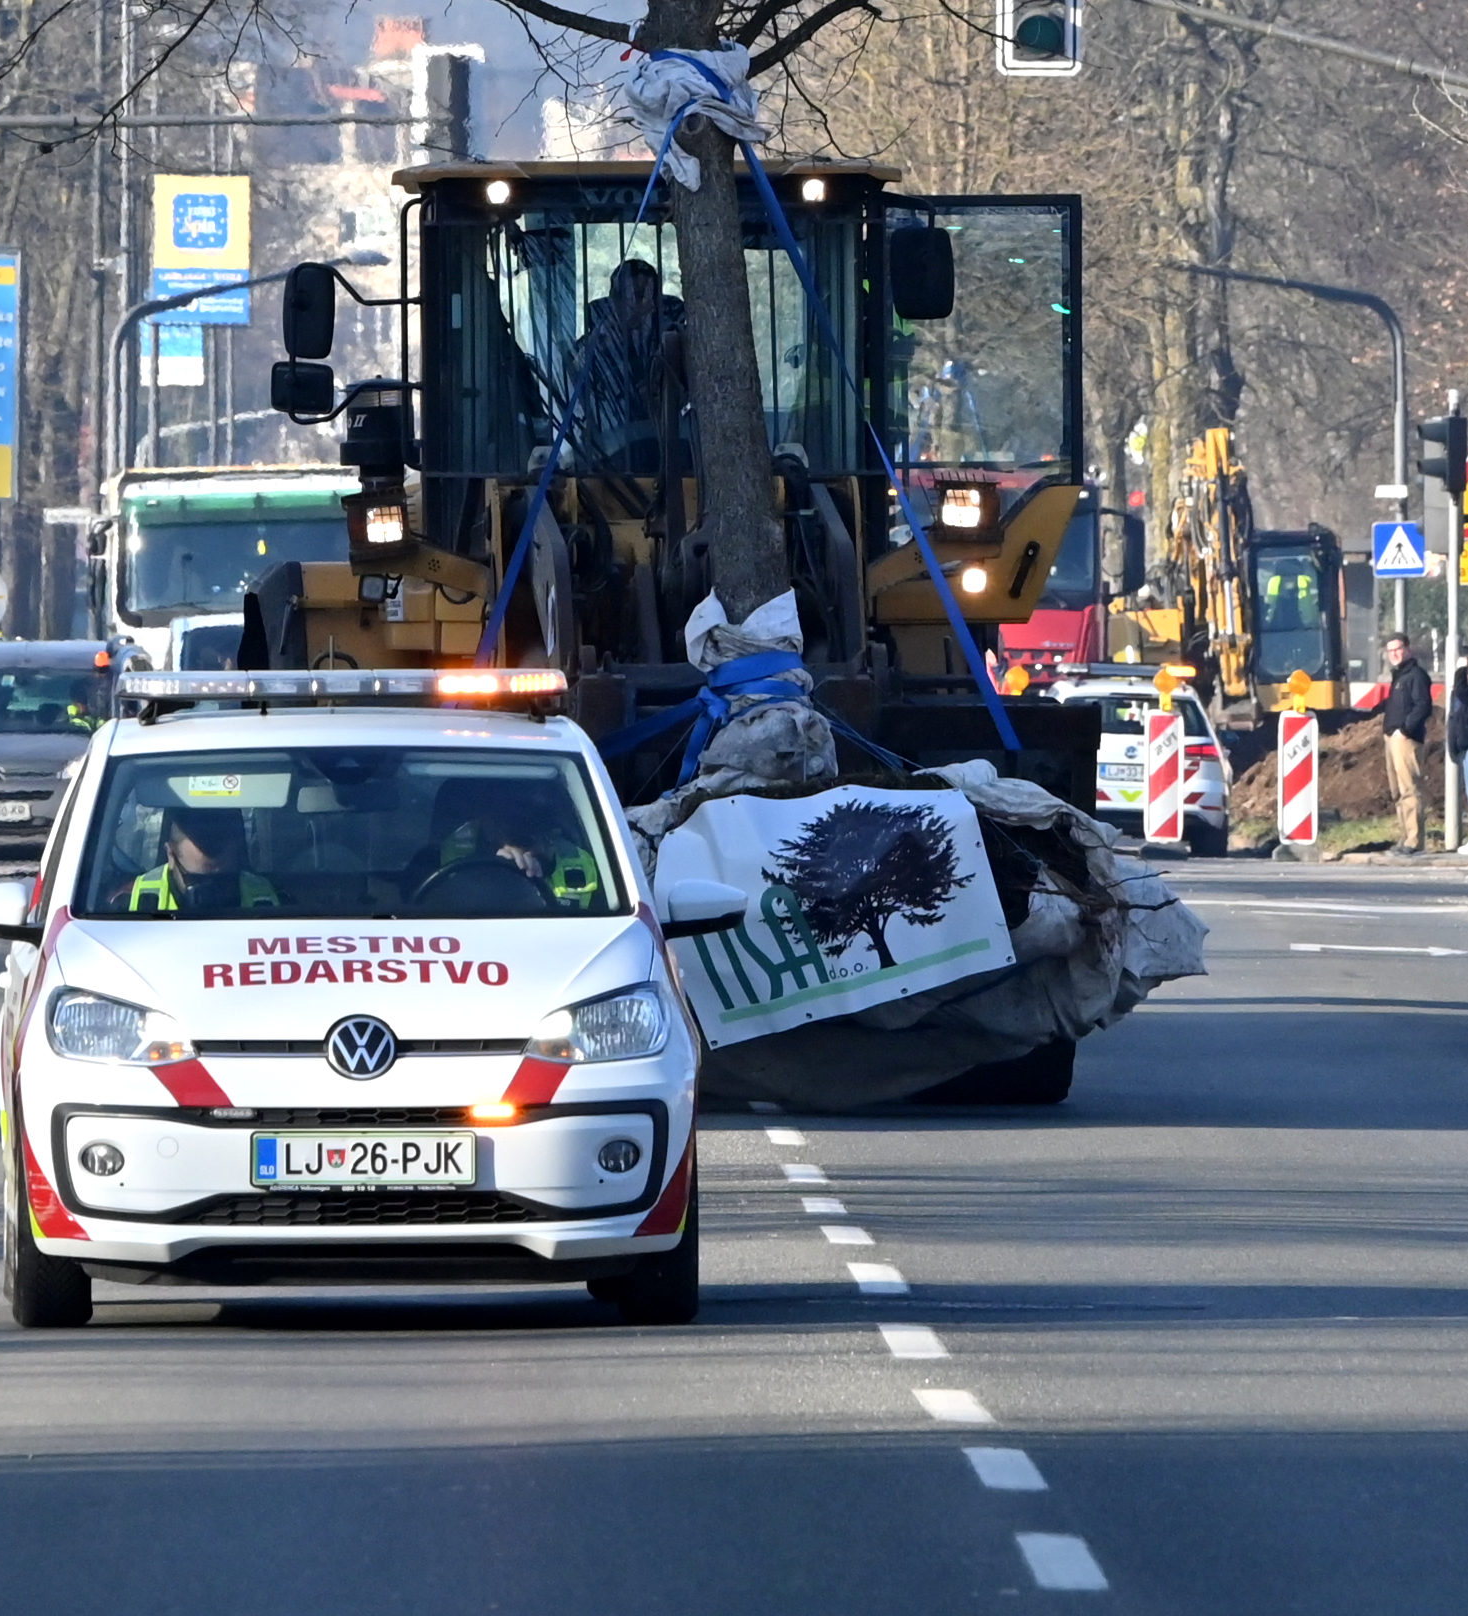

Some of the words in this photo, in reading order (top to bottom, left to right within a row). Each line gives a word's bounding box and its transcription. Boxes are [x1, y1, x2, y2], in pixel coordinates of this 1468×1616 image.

[247, 936, 461, 955] MESTNO
[203, 959, 509, 988] REDARSTVO
[828, 963, 869, 980] d.o.o.
[285, 1142, 323, 1175] LJ
[350, 1142, 463, 1175] 26-PJK
[259, 1166, 275, 1175] SLO
